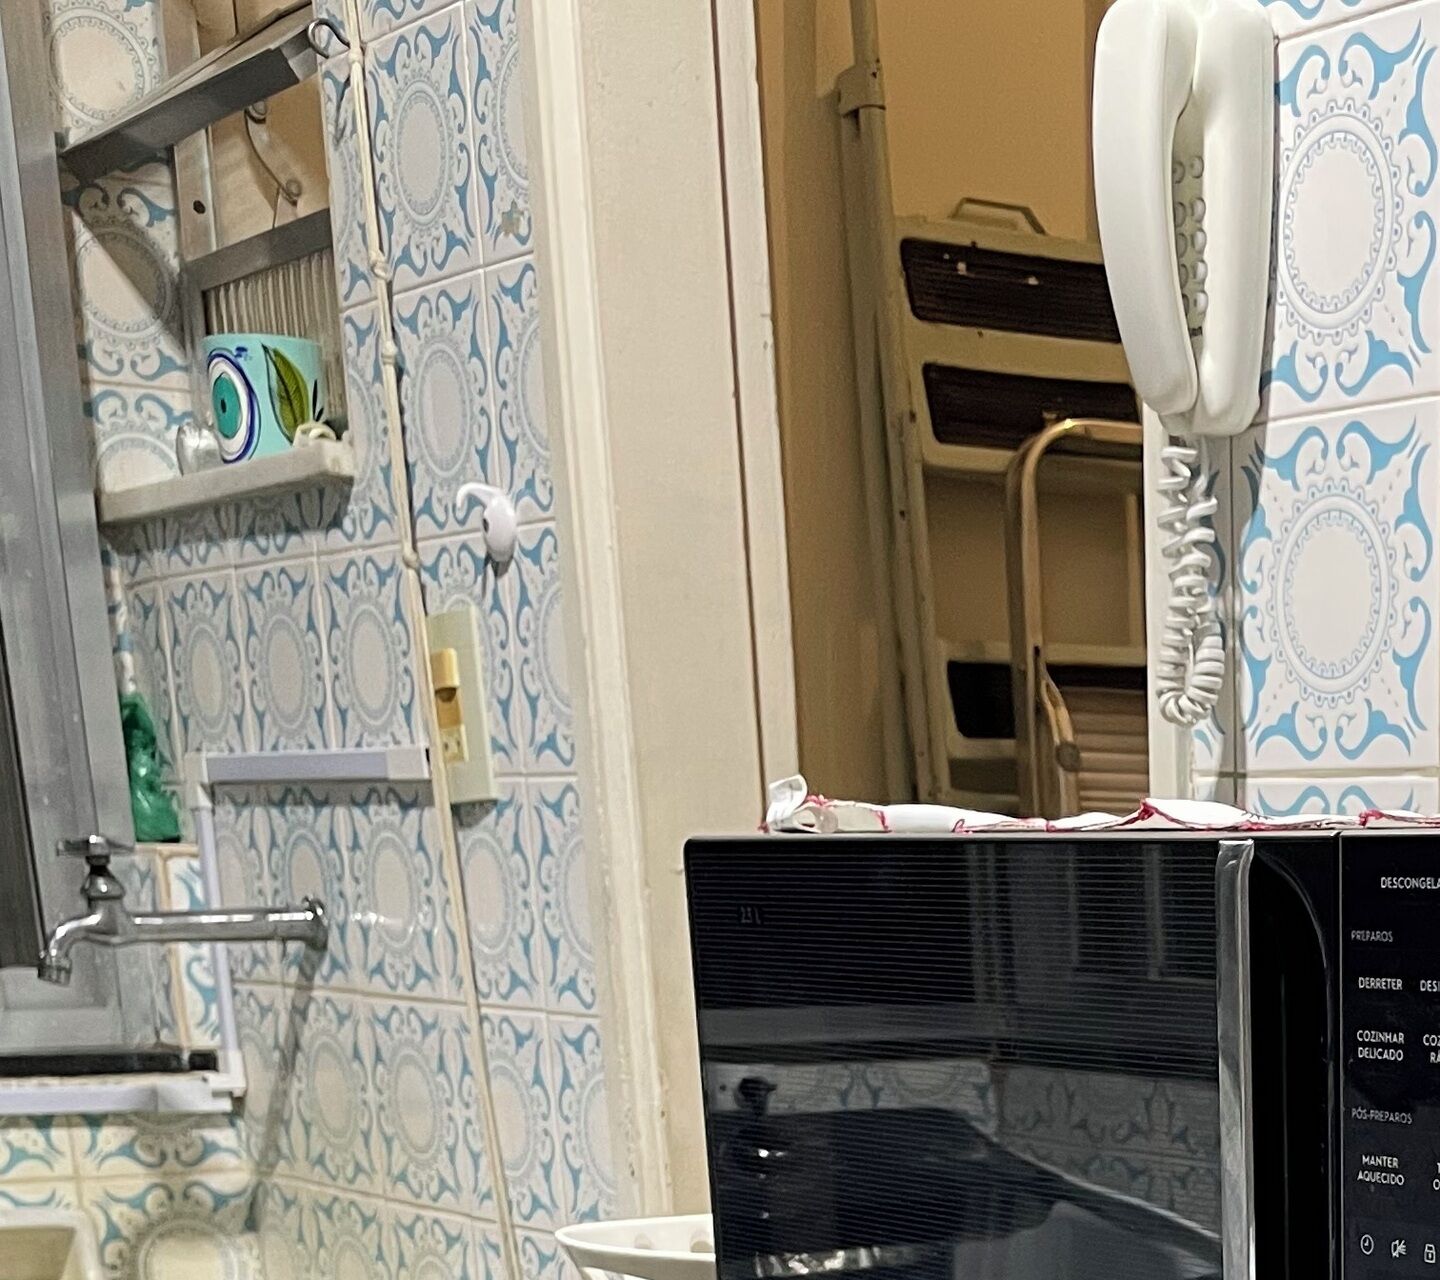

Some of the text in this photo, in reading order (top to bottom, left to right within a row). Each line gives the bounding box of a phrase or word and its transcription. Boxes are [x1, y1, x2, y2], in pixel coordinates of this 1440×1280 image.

[1351, 930, 1393, 942] PREPAROS
[1358, 976, 1403, 991] DERRETER
[1356, 1029, 1405, 1044] COZINHAR
[1357, 1047, 1404, 1061] DELICADO
[1362, 1154, 1399, 1169] MANTER
[1356, 1170, 1405, 1186] AQUECIDO
